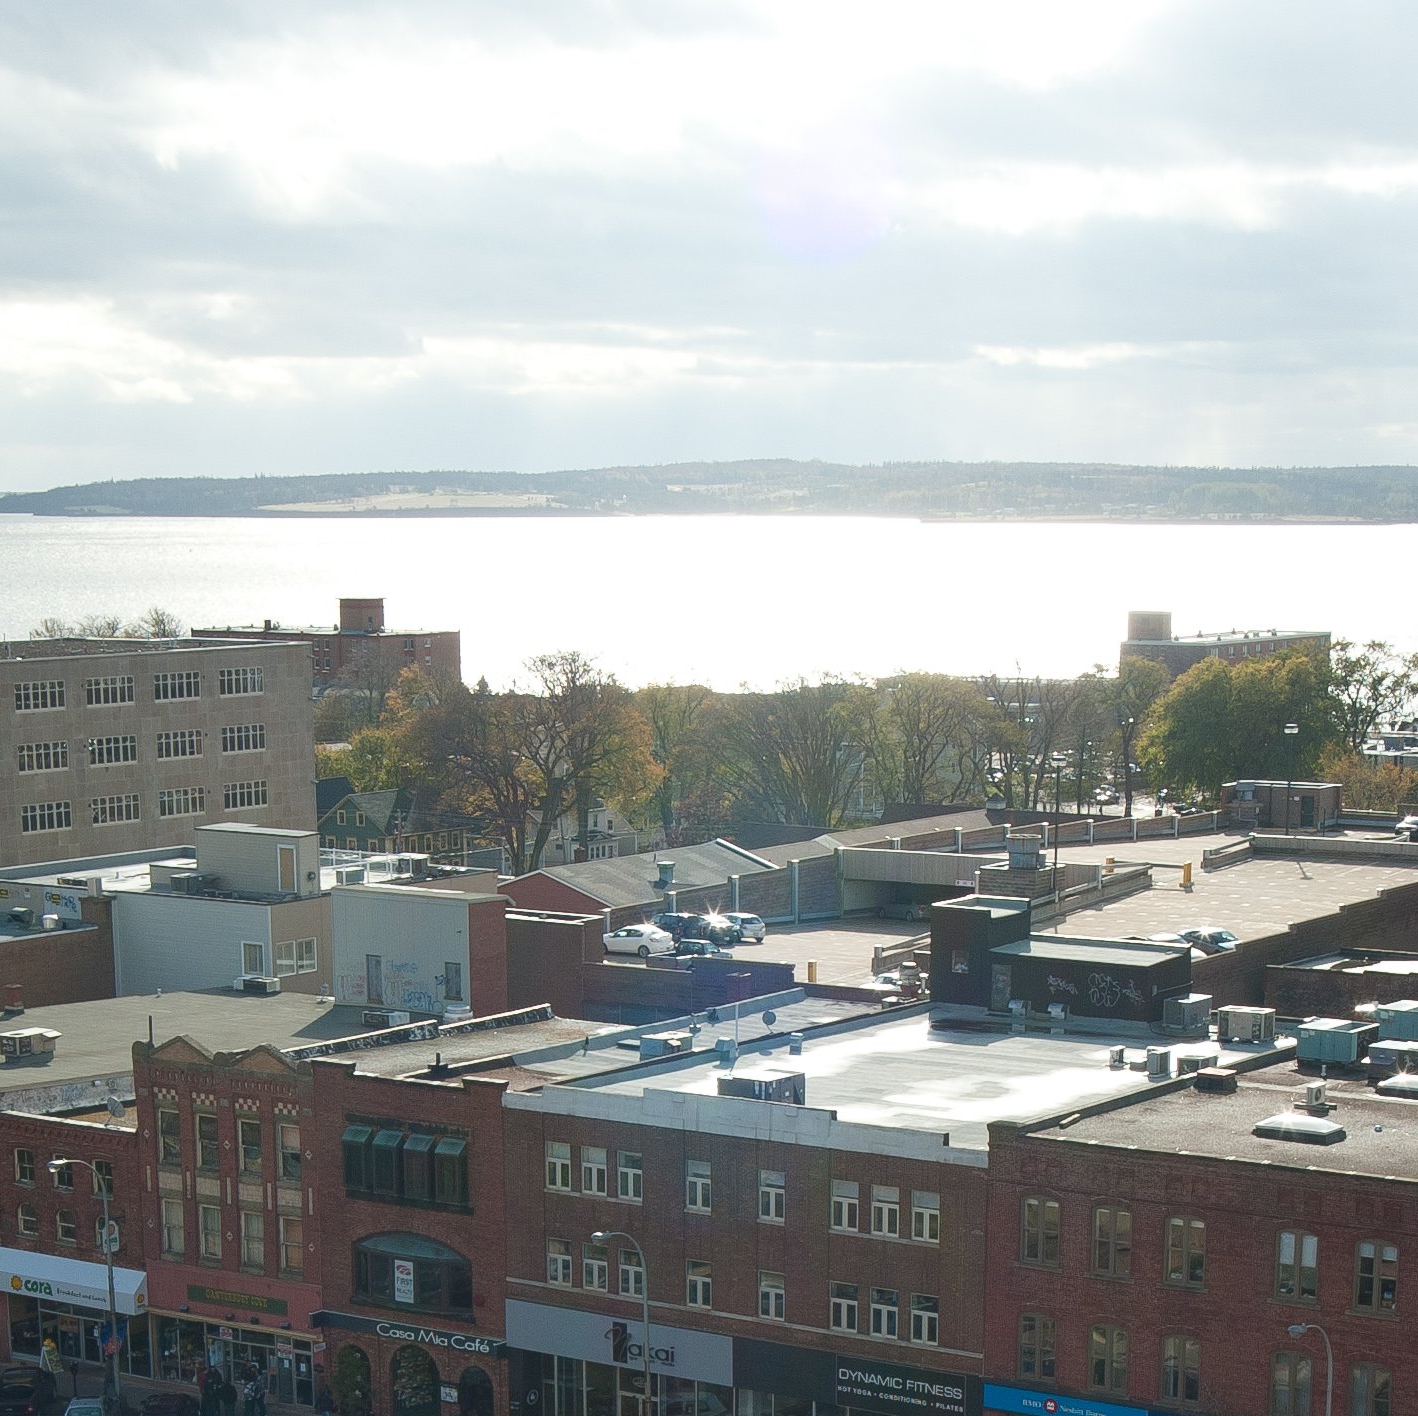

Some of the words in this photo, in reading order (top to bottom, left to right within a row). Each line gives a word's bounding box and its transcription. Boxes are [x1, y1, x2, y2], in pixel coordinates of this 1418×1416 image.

[24, 1278, 54, 1297] cora
[376, 1323, 415, 1341] Casa
[417, 1330, 448, 1346] Mia
[451, 1335, 490, 1353] Café
[838, 1368, 902, 1389] DYNAMIC
[906, 1380, 963, 1400] FITNESS
[853, 1388, 872, 1397] YOGA
[935, 1402, 963, 1413] PILATES
